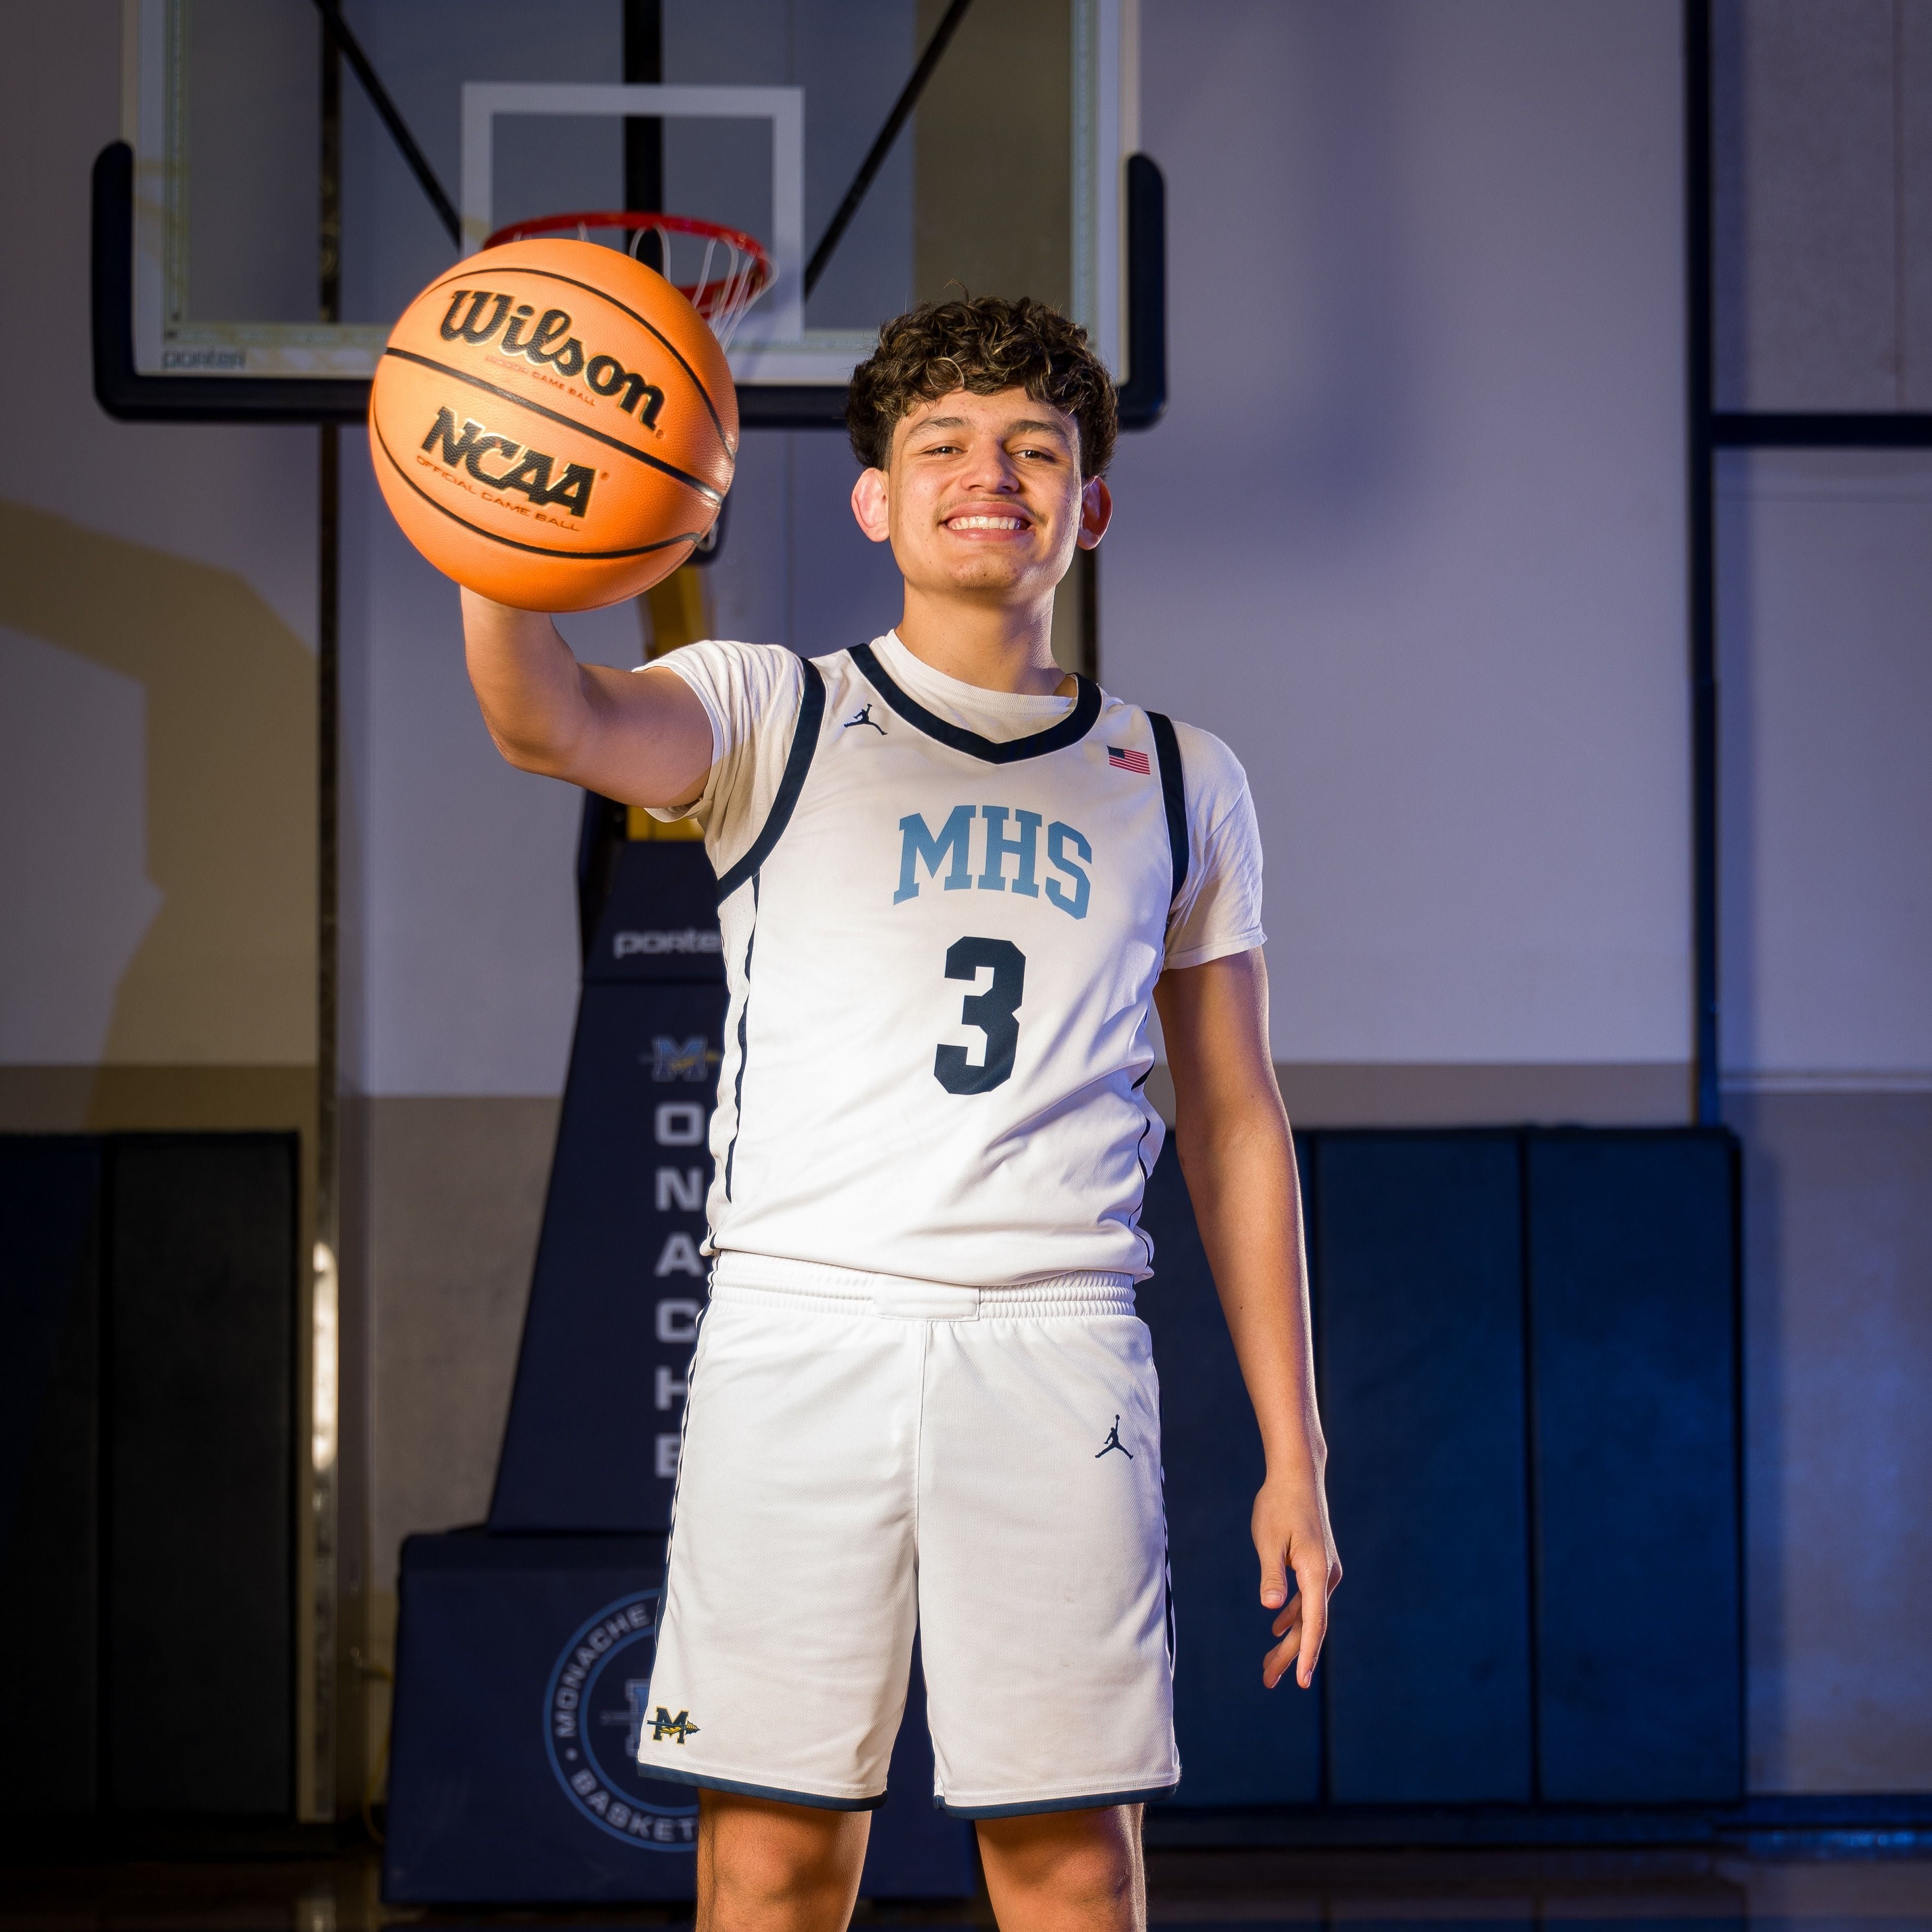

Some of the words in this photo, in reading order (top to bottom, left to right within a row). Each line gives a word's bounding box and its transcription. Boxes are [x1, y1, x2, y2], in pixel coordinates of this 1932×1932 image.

[440, 290, 664, 432] Wilson
[533, 372, 566, 390] GAME
[568, 387, 595, 406] BALL
[416, 455, 477, 495] OFFICIAL
[481, 492, 530, 516] GAME
[535, 512, 580, 532] BALL
[420, 406, 597, 518] NCAA
[893, 805, 1092, 920] MHS
[614, 927, 721, 959] porte
[934, 936, 1026, 1095] 3
[555, 1603, 651, 1738] MONACHE
[652, 1705, 690, 1745] M
[570, 1768, 697, 1842] BASKET
